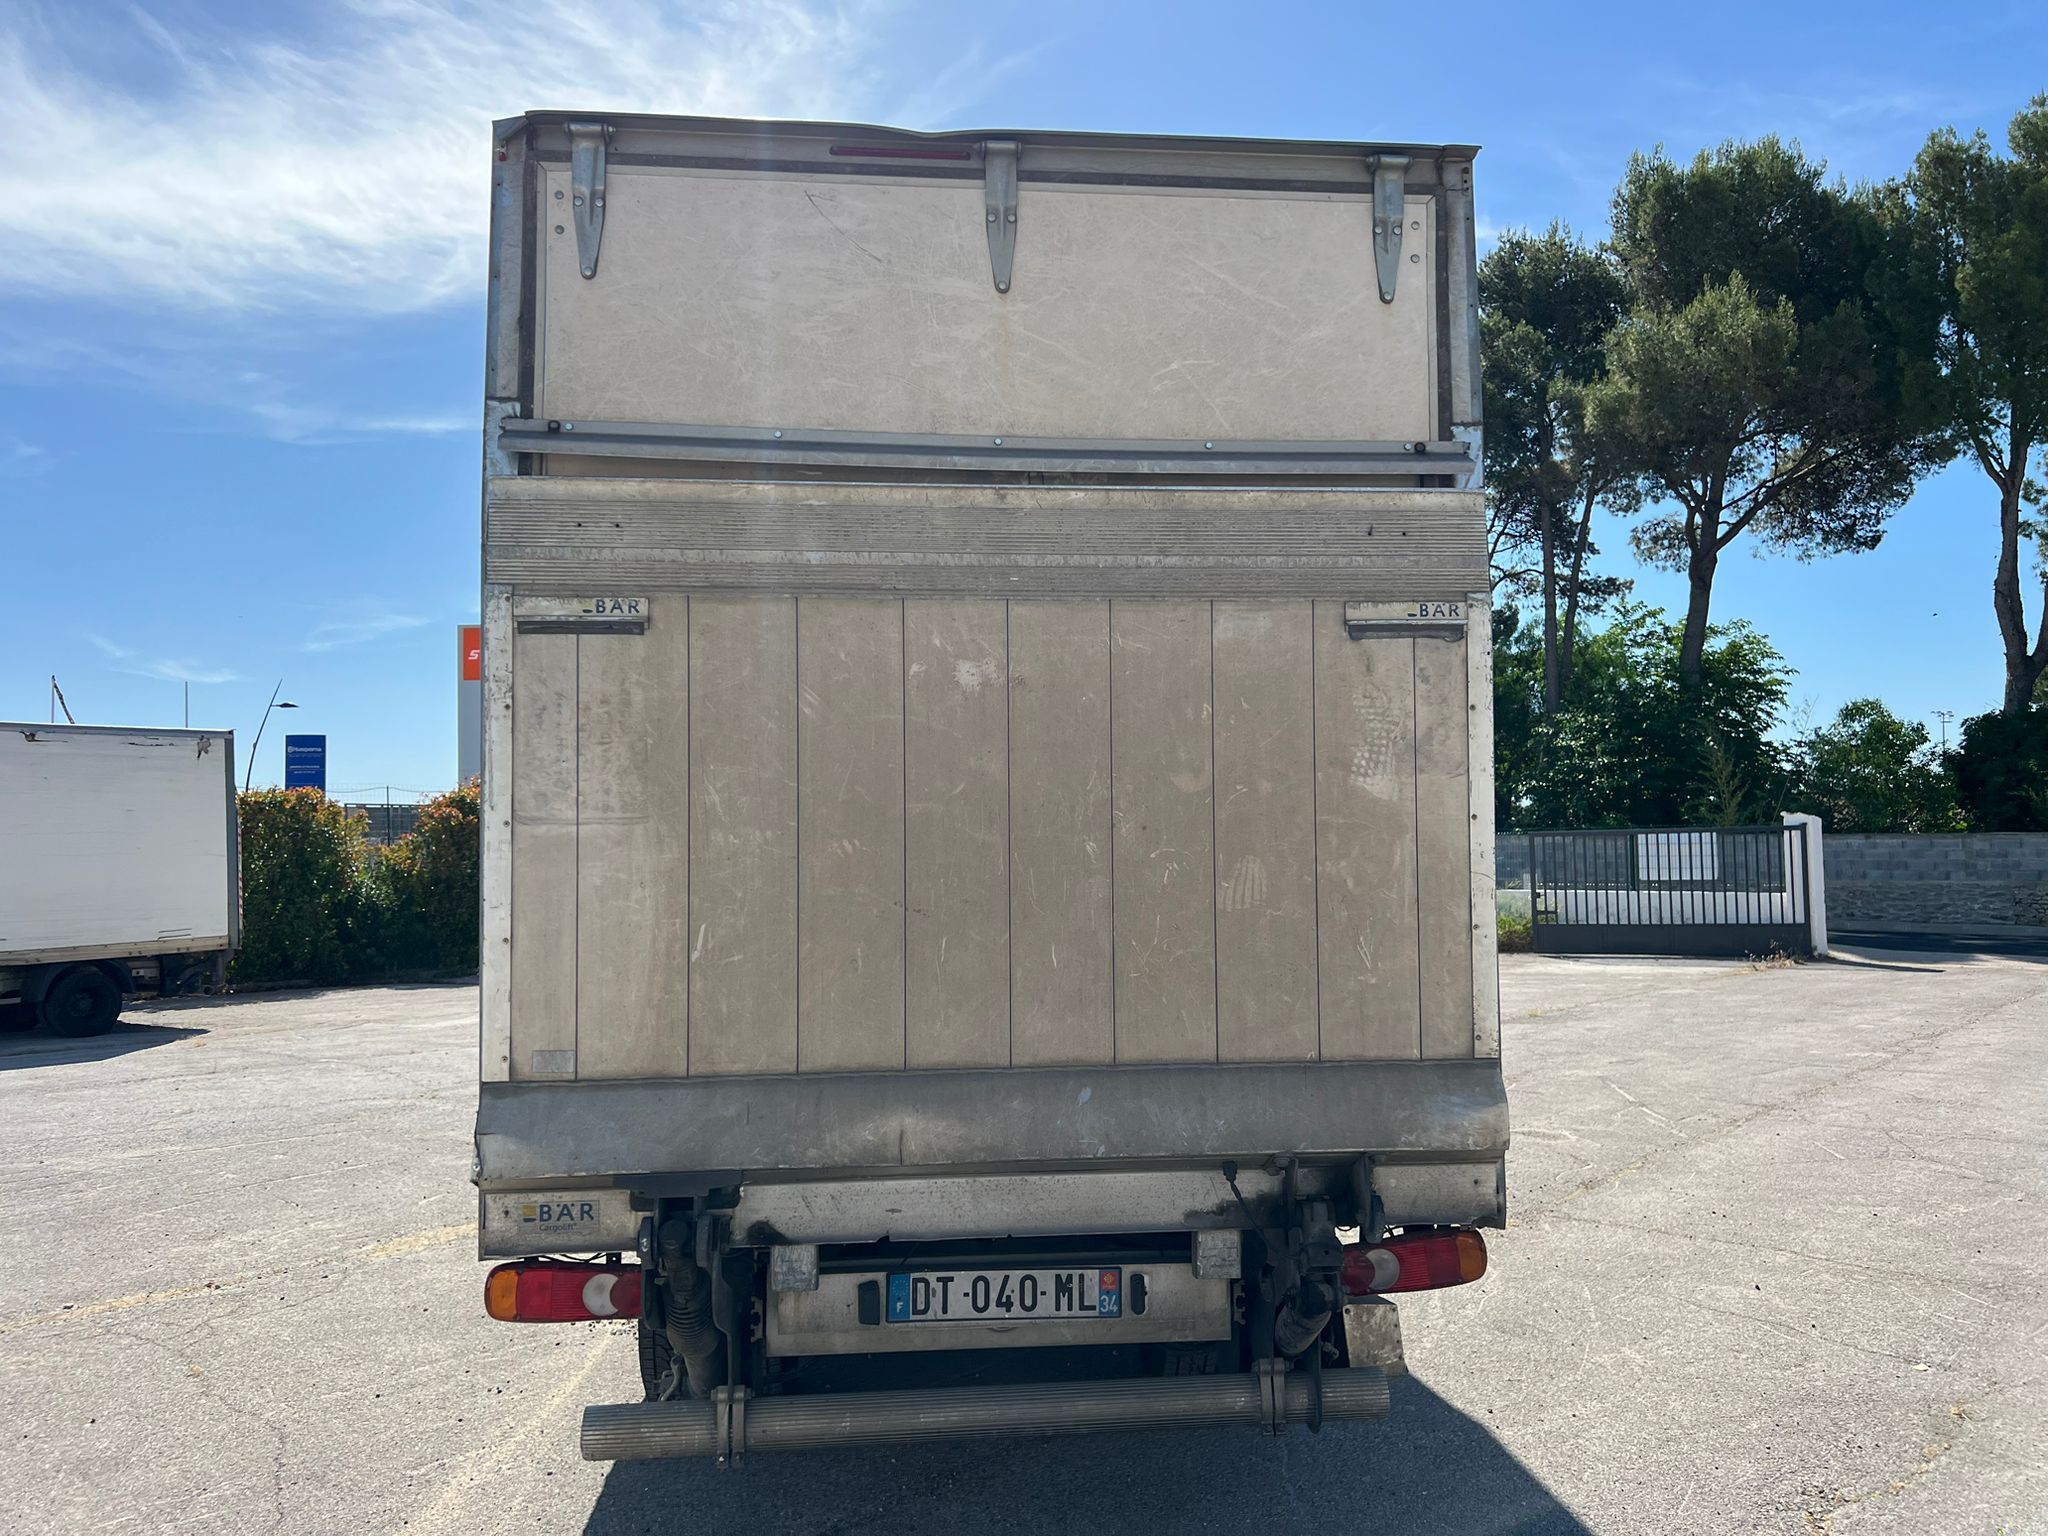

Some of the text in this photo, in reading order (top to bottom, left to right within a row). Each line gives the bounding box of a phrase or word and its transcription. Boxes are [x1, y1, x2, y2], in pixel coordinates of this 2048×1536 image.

[1419, 603, 1460, 618] BÄR
[539, 1203, 594, 1222] BÄR
[896, 1302, 903, 1313] F
[1100, 1295, 1118, 1312] 34
